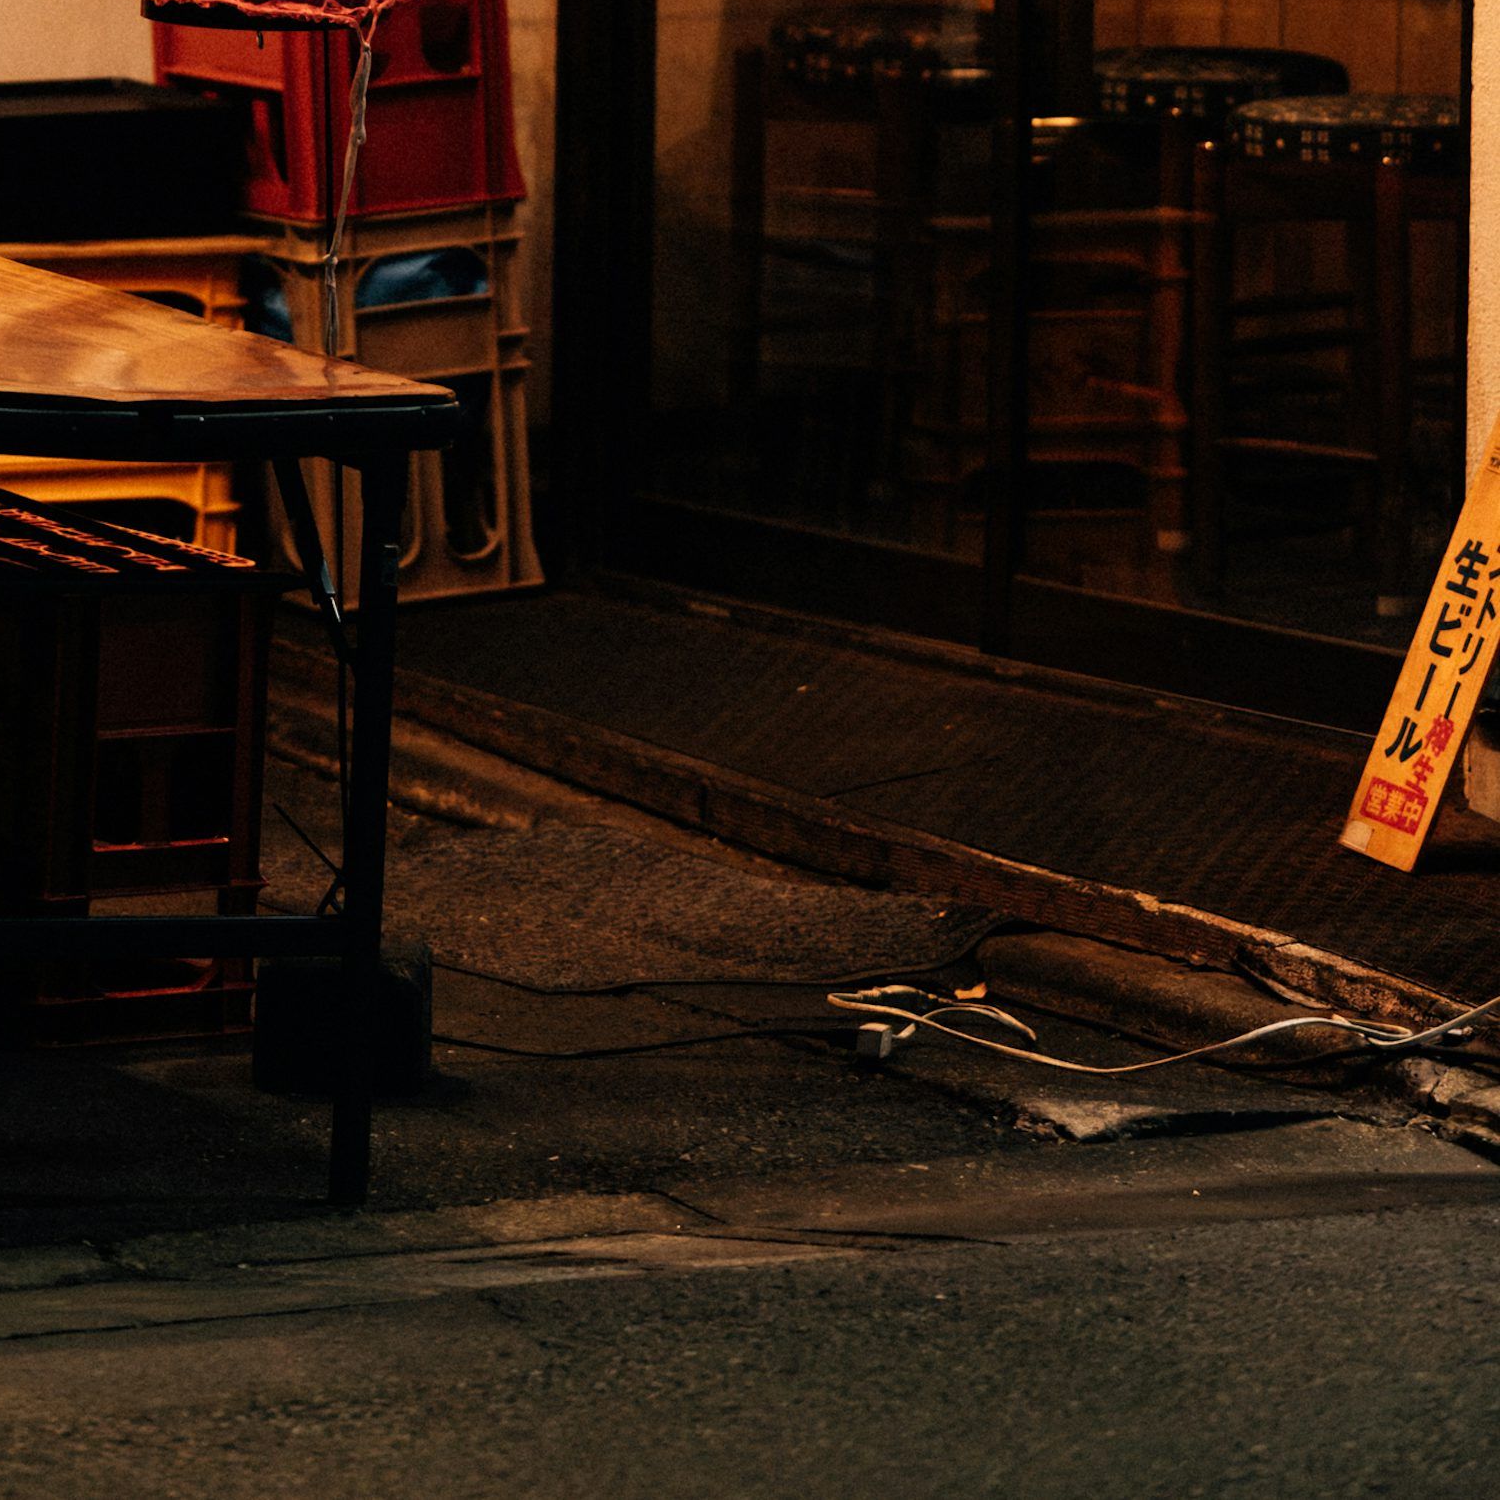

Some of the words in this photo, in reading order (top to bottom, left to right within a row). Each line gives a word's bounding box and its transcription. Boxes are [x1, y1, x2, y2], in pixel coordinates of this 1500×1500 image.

[1384, 539, 1489, 763] 生ビール
[1364, 782, 1423, 828] 営業中
